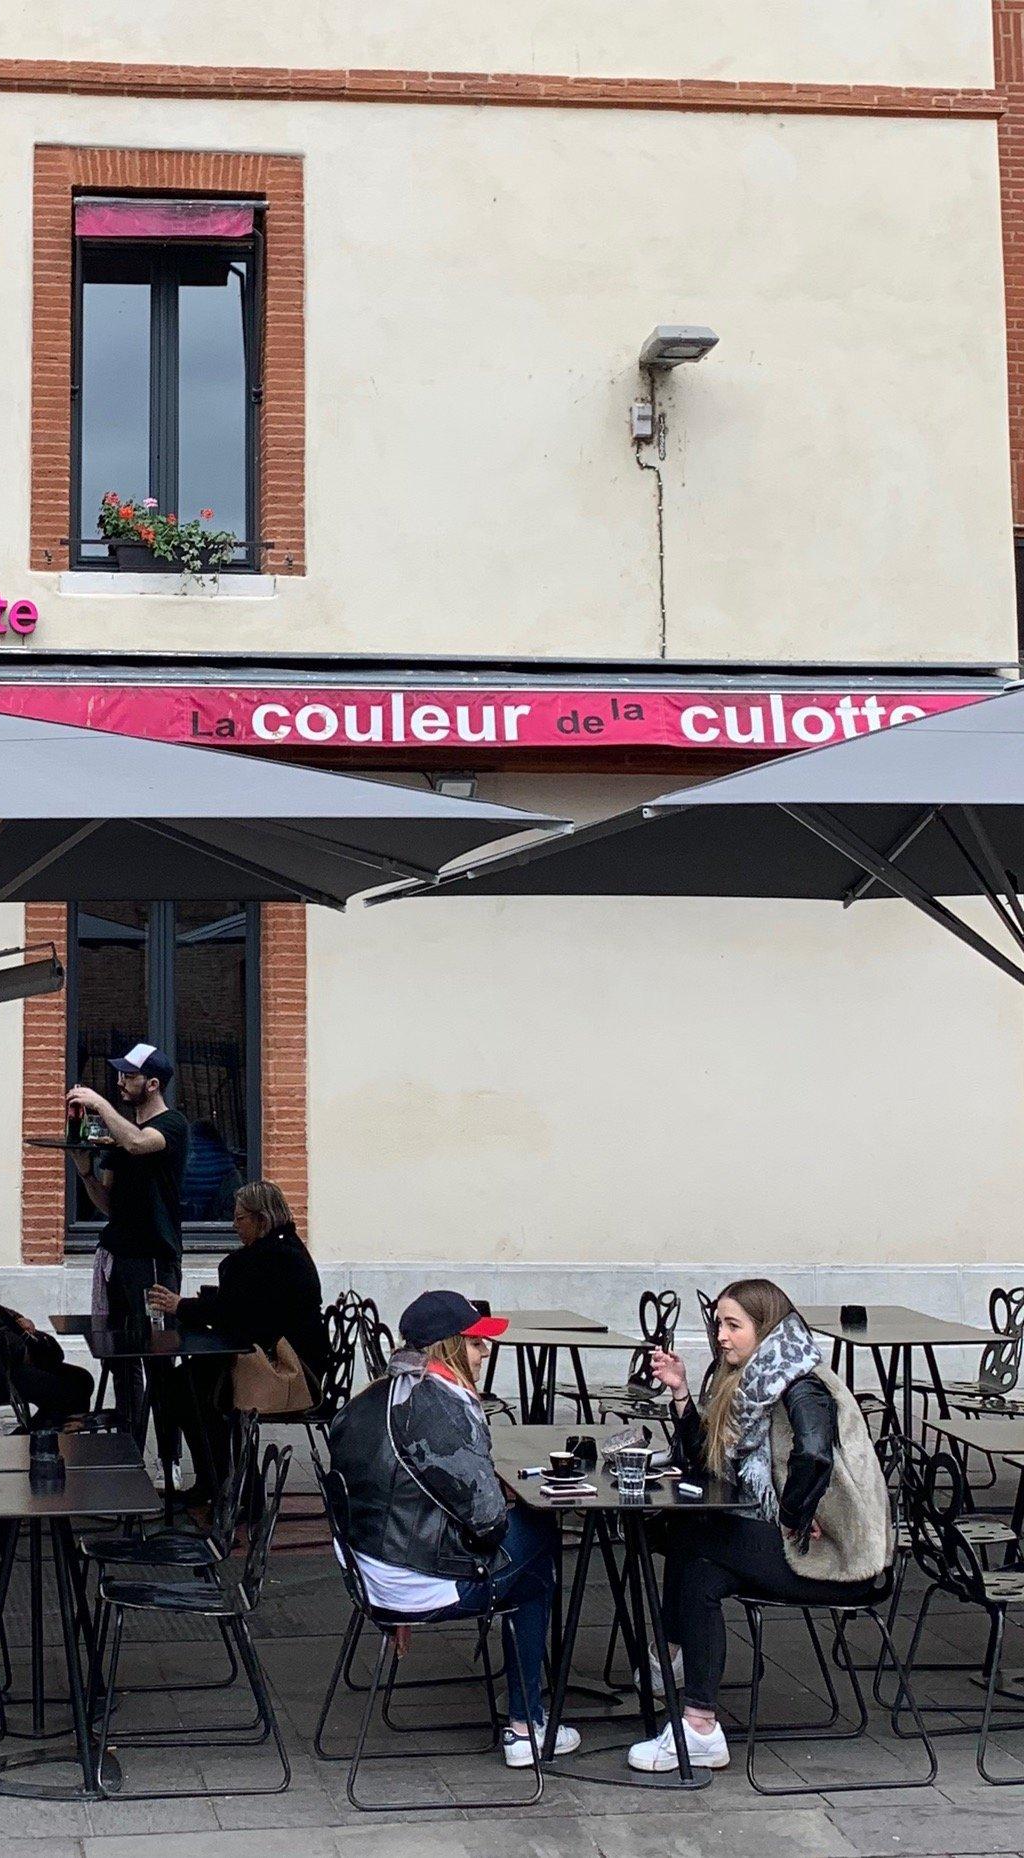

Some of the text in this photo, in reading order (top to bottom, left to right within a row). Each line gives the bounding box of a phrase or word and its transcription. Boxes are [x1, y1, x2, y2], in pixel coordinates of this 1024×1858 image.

[191, 710, 236, 738] La
[251, 692, 532, 742] couleur
[556, 709, 604, 735] de
[609, 698, 645, 721] la
